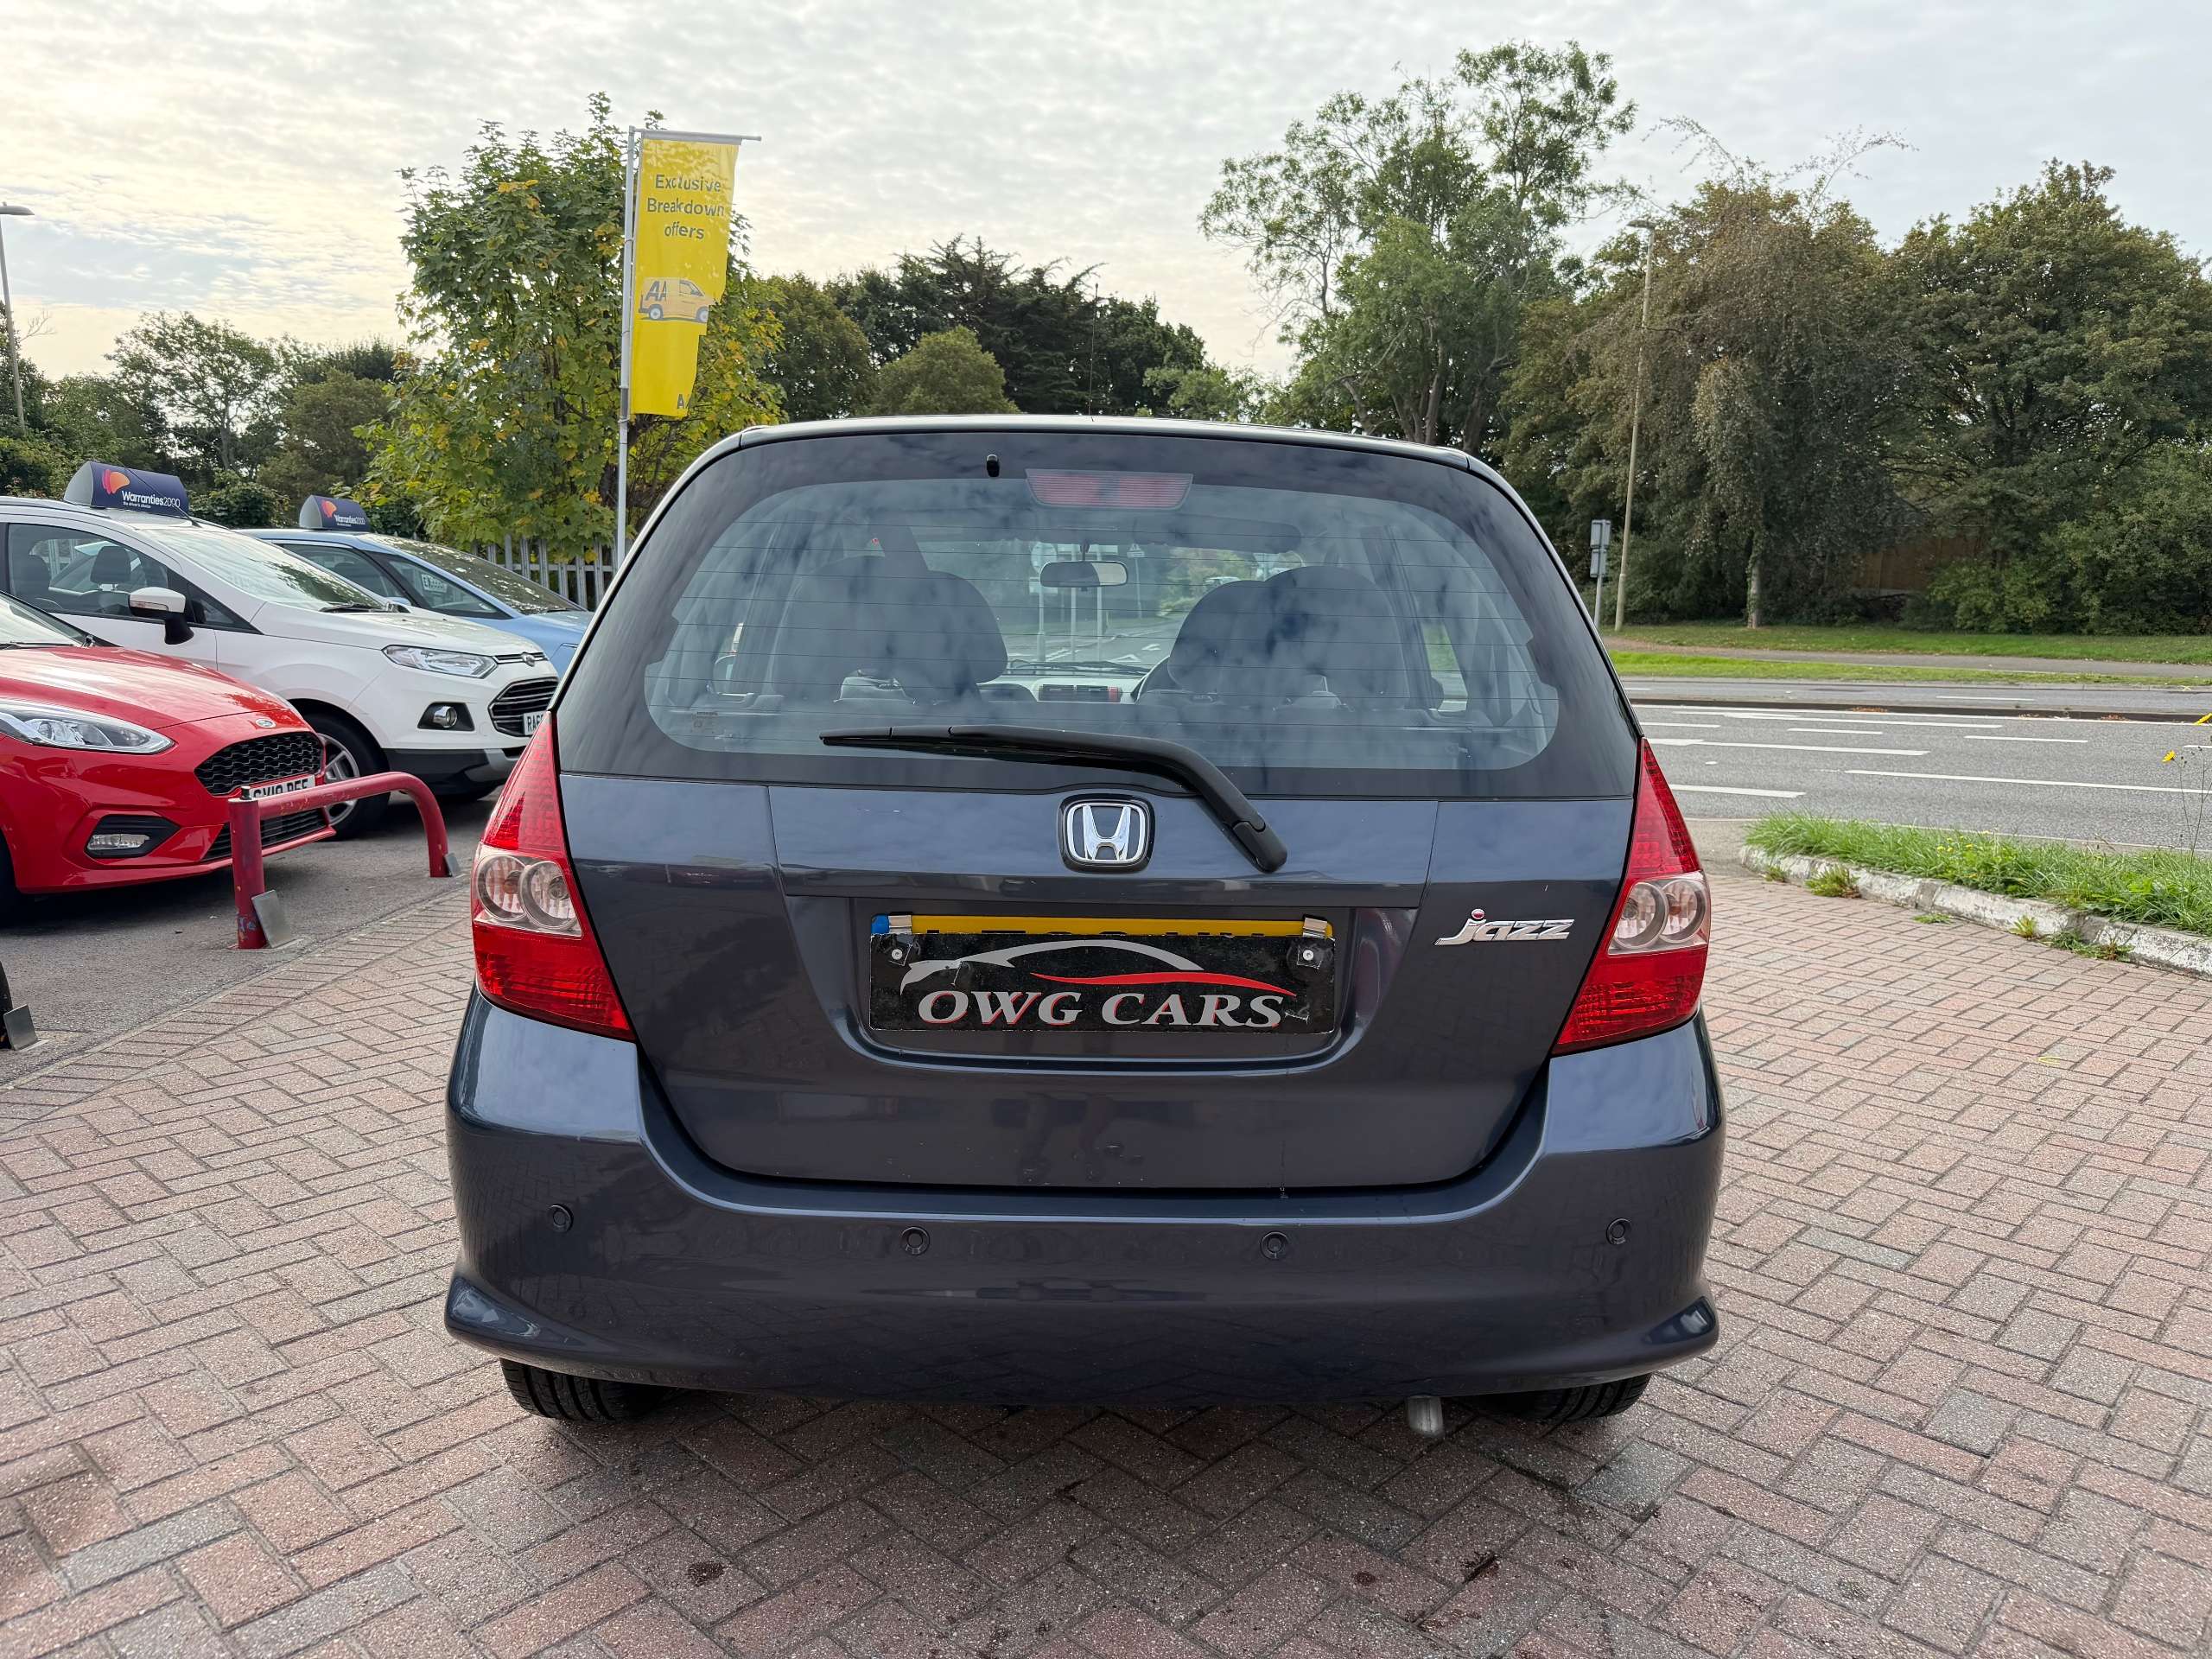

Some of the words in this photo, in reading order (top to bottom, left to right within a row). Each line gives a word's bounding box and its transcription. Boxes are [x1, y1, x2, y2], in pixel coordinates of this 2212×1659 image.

[655, 174, 721, 192] Exclusive
[647, 197, 725, 216] Breakdown
[664, 221, 704, 239] offers
[122, 490, 181, 507] Warranties2000
[1434, 908, 1575, 946] jazz
[918, 990, 1084, 1027] OWG
[1101, 993, 1284, 1028] CARS
